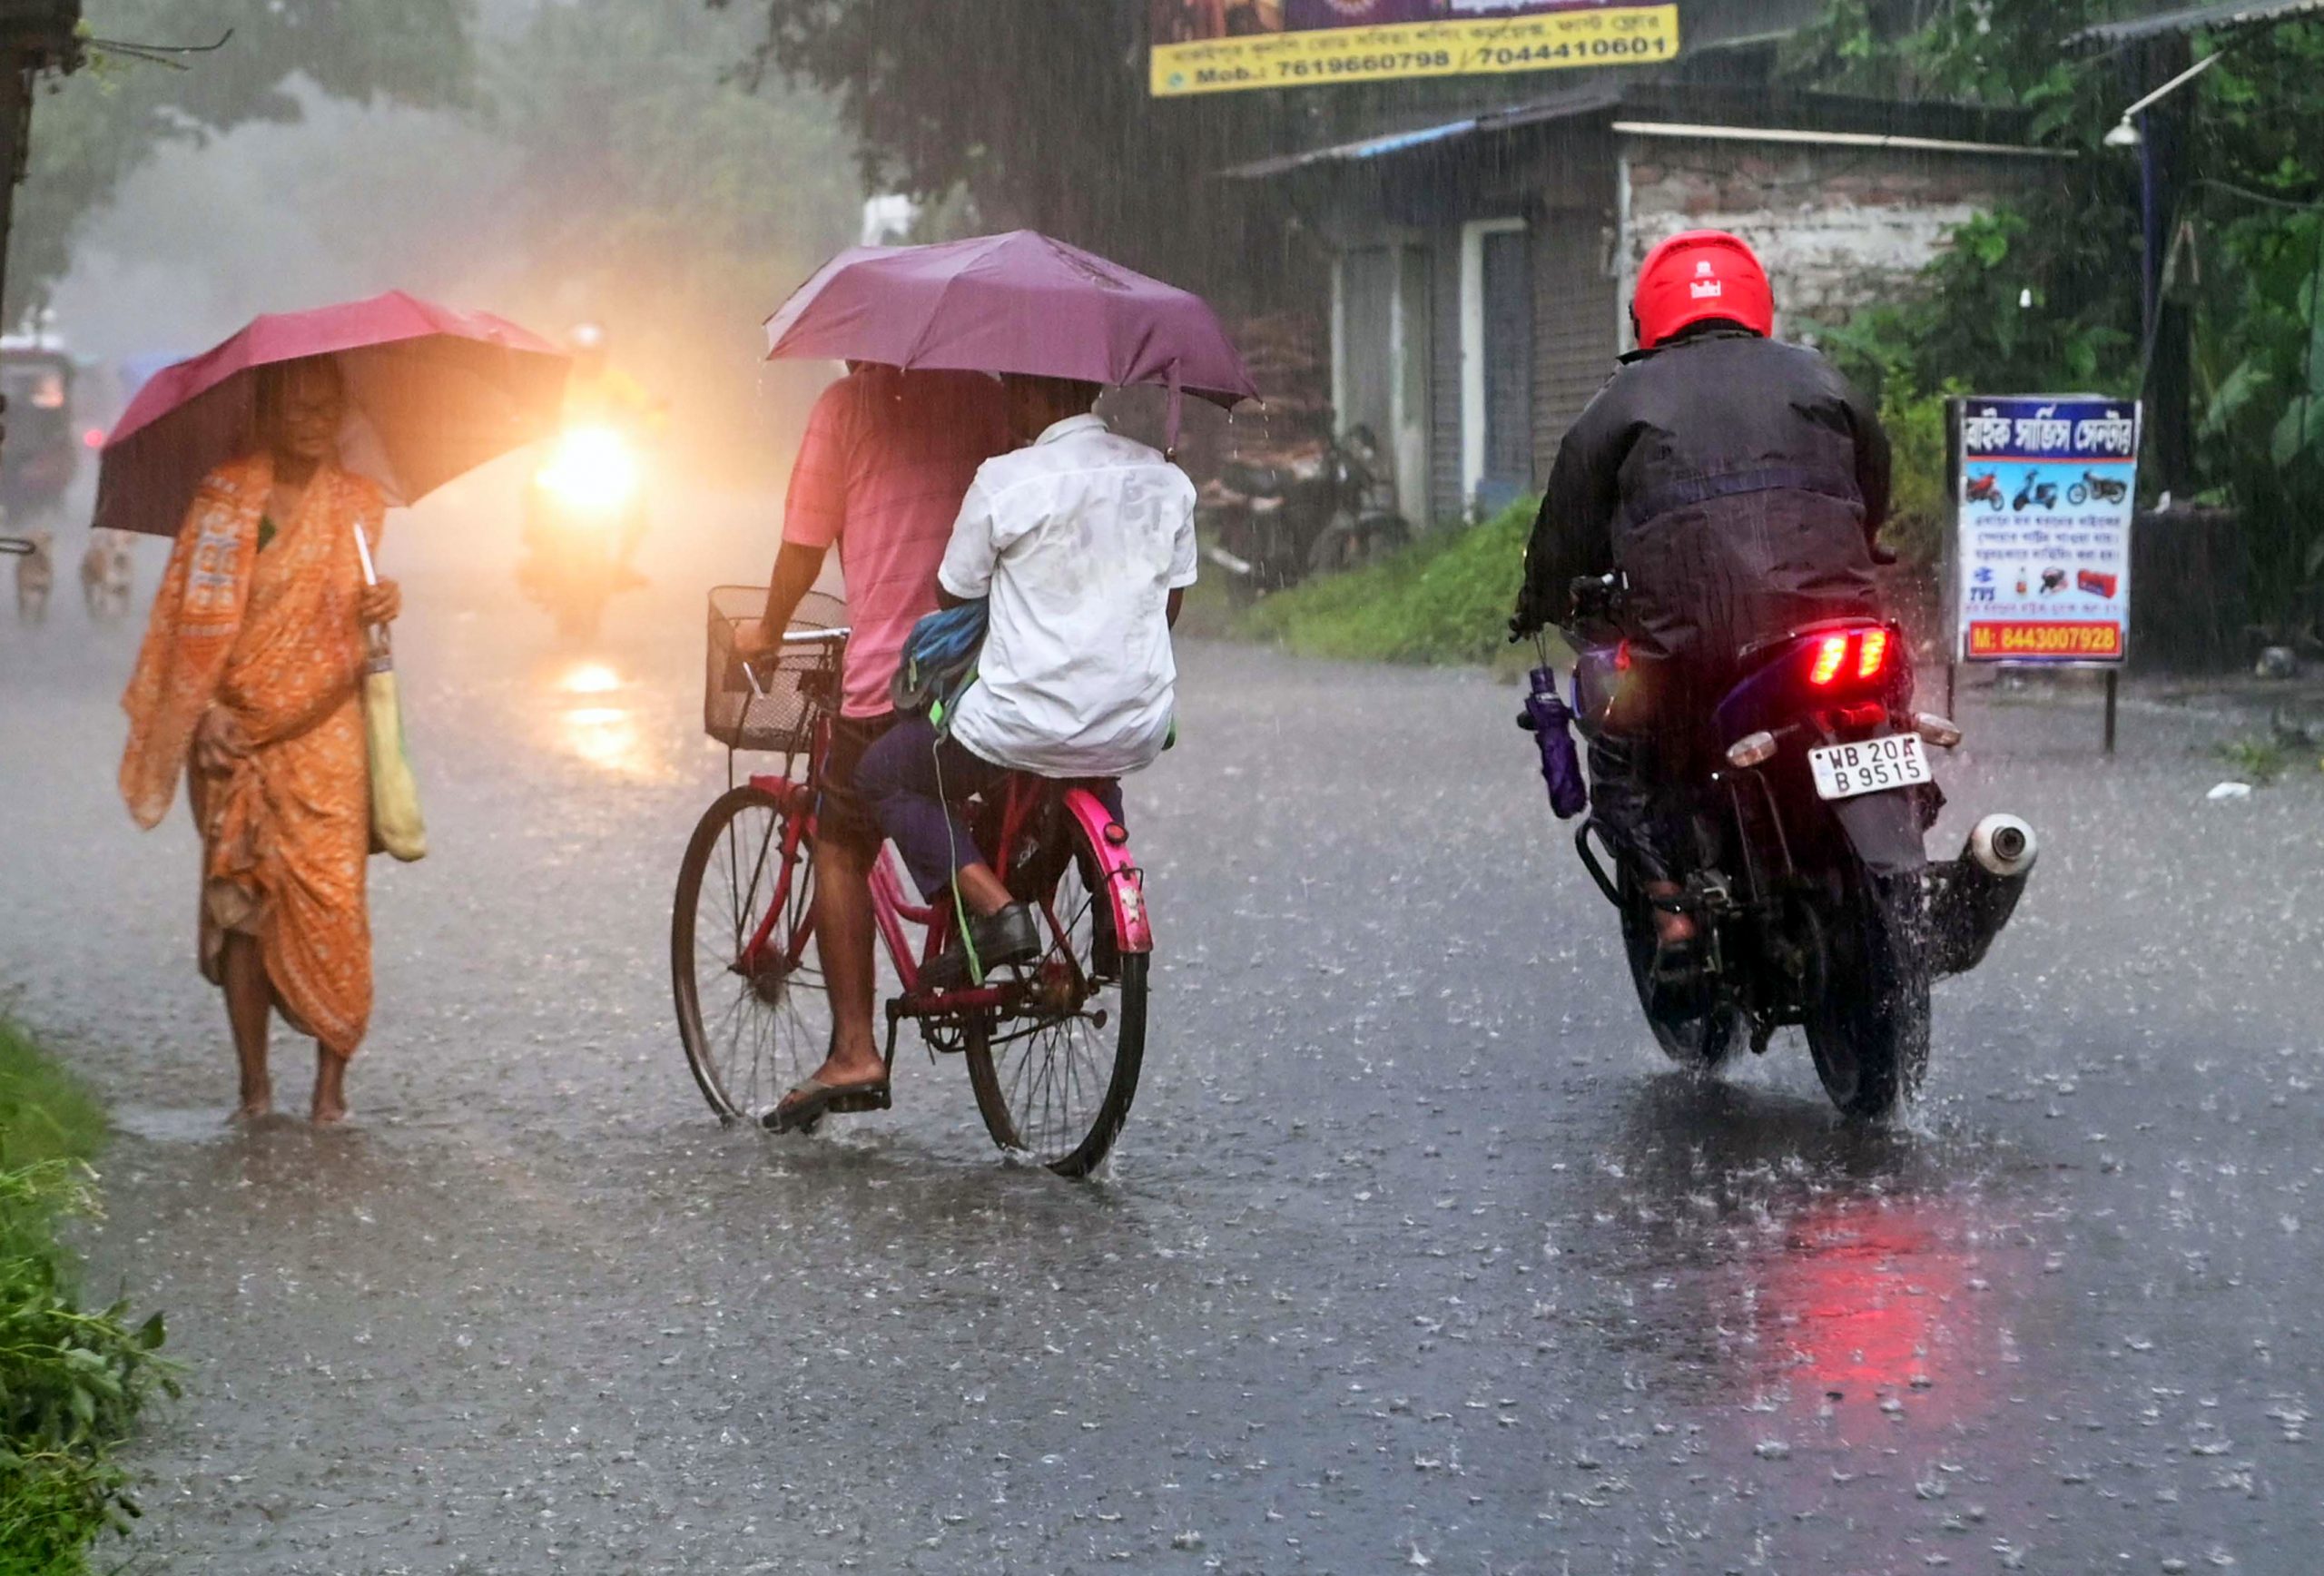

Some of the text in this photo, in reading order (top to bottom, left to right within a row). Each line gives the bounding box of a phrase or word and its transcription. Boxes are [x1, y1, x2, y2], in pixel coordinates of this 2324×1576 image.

[1277, 50, 1450, 77] 7619660798
[1479, 36, 1667, 65] 7044410601
[1965, 404, 2133, 455] বাইক সার্ভিস সেন্টার
[2002, 626, 2115, 650] 8443007928
[1828, 746, 1859, 770] WB
[1835, 759, 1921, 793] B 9515
